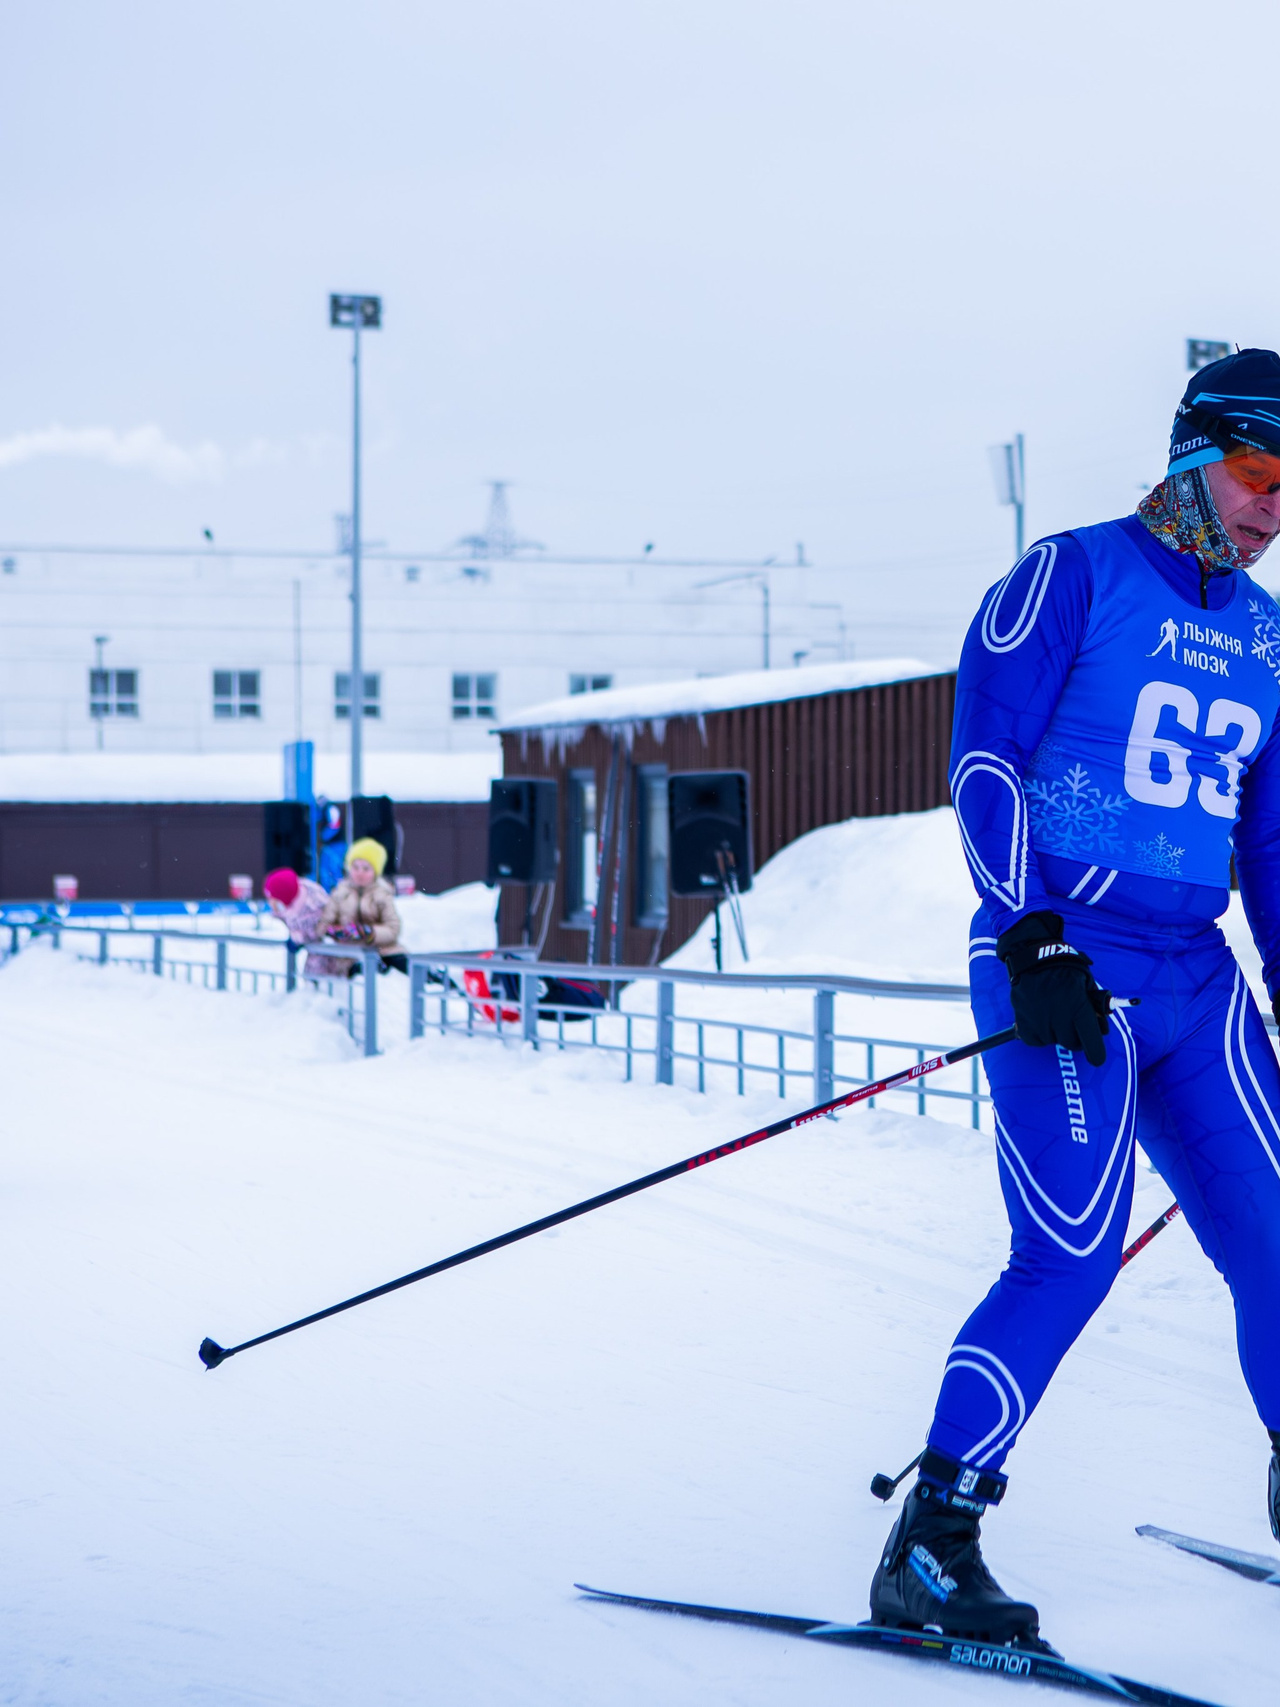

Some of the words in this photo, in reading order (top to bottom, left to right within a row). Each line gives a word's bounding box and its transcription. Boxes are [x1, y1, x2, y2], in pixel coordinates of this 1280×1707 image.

[1183, 621, 1243, 657] ЛЫЖНЯ
[1183, 648, 1230, 677] МОЭК
[1124, 681, 1262, 820] 63
[951, 1495, 985, 1513] SPINE
[911, 1544, 958, 1593] SPINE
